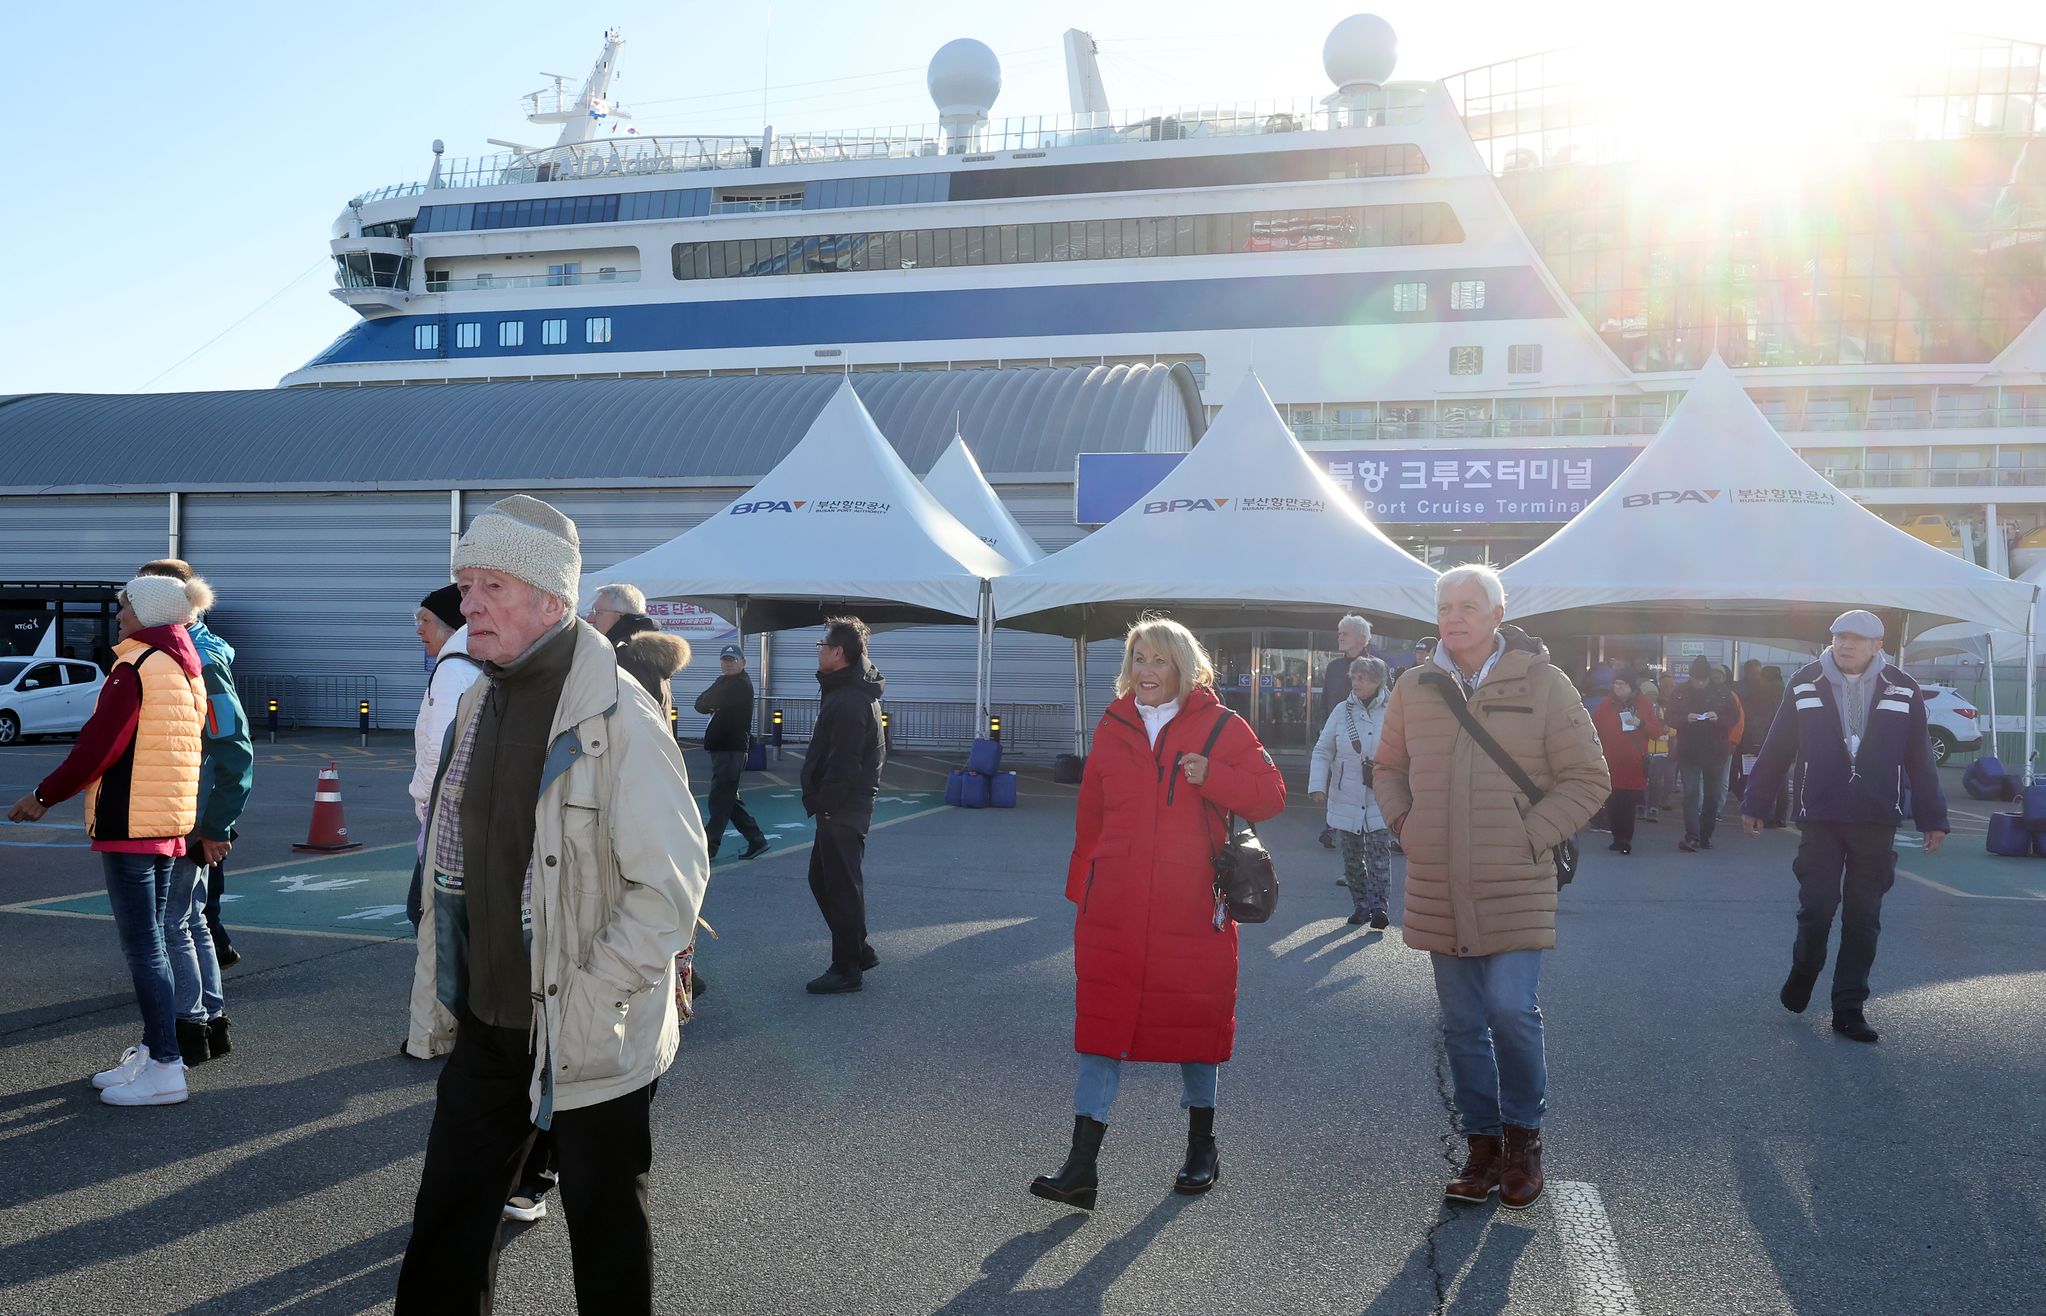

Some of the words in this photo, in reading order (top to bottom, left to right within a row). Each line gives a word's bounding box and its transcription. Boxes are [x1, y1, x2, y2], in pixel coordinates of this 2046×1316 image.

[1400, 458, 1592, 491] 크루즈터미널
[1622, 489, 1708, 508] BPA
[1738, 488, 1834, 502] 부산항만공사
[730, 501, 792, 515] BPA
[817, 500, 891, 512] 부산항만공사
[1143, 498, 1216, 514] BPA
[1242, 497, 1326, 510] 부산항만공사
[1363, 500, 1407, 514] Port
[1417, 500, 1485, 514] Cruise
